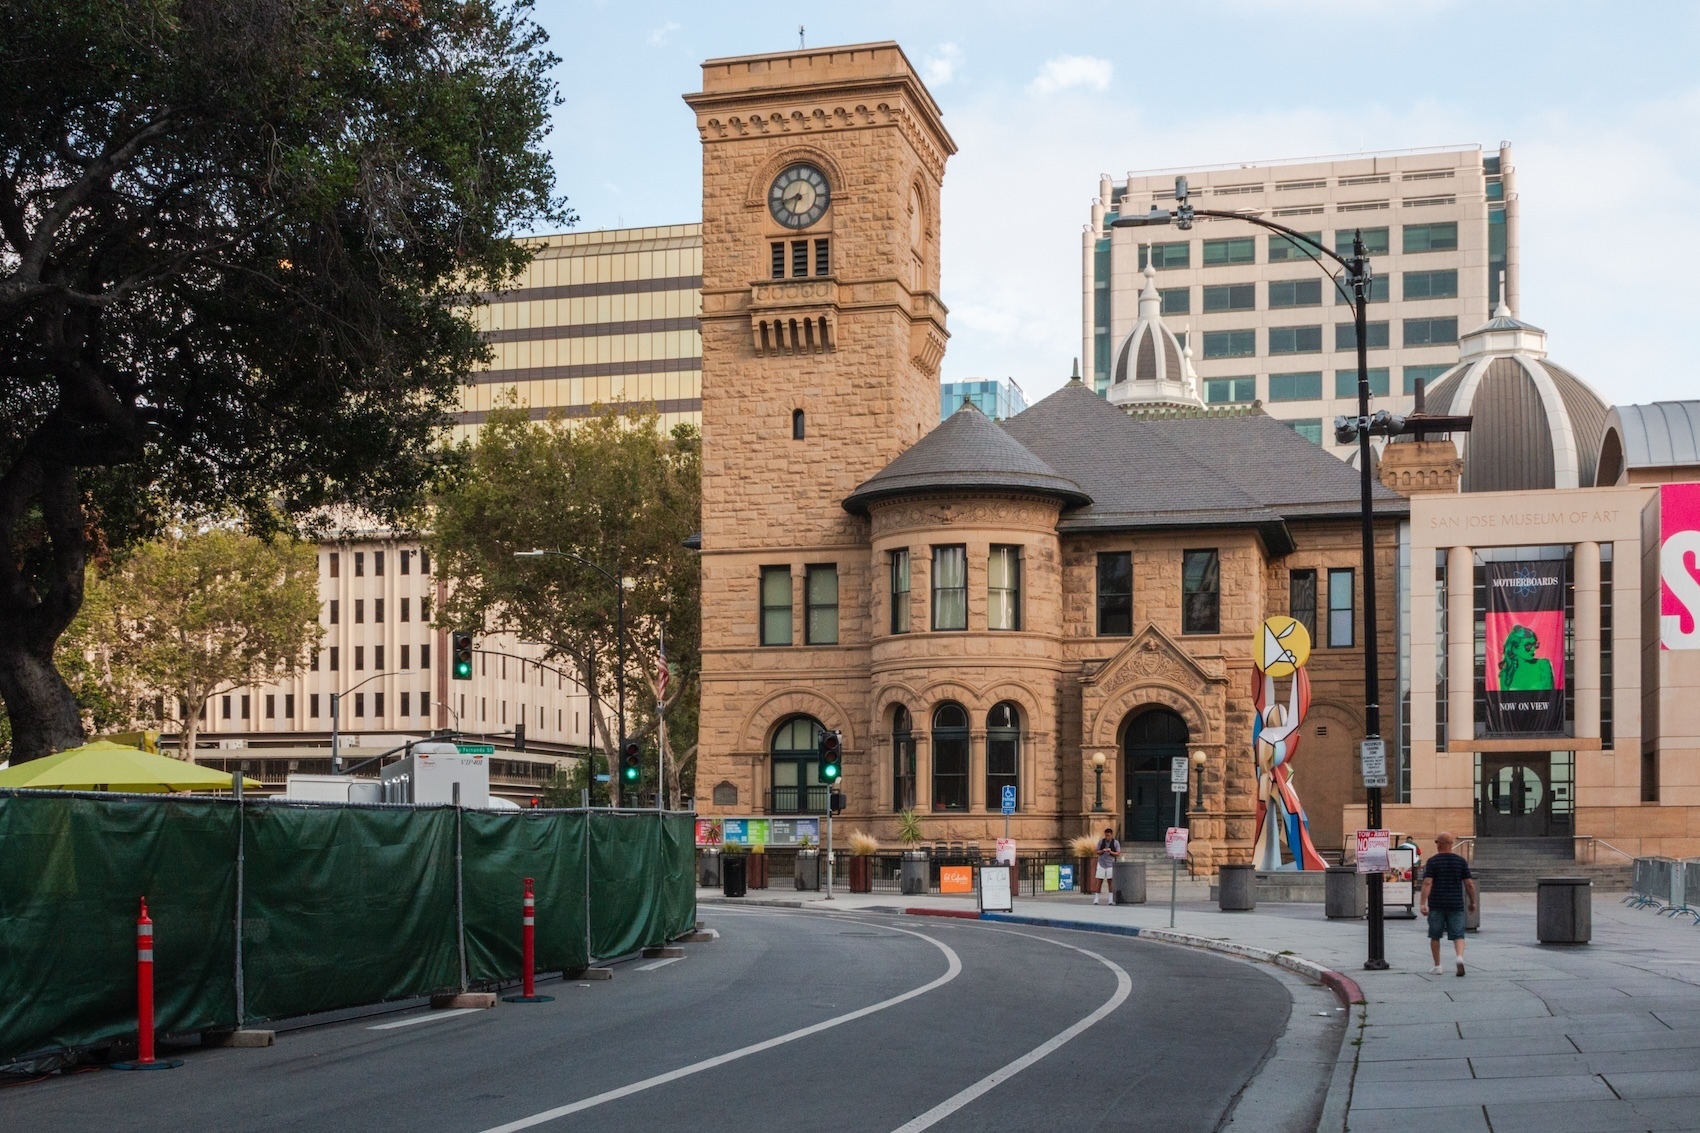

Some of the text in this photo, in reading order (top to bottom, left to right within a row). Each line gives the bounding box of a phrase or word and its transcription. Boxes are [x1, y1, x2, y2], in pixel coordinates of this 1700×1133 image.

[1430, 510, 1619, 529] SAN JOSE MUSEUM OF ART
[1493, 577, 1558, 587] MOTHERBOARDS
[1500, 702, 1549, 711] NOW ON VIEW
[1358, 838, 1368, 851] NO
